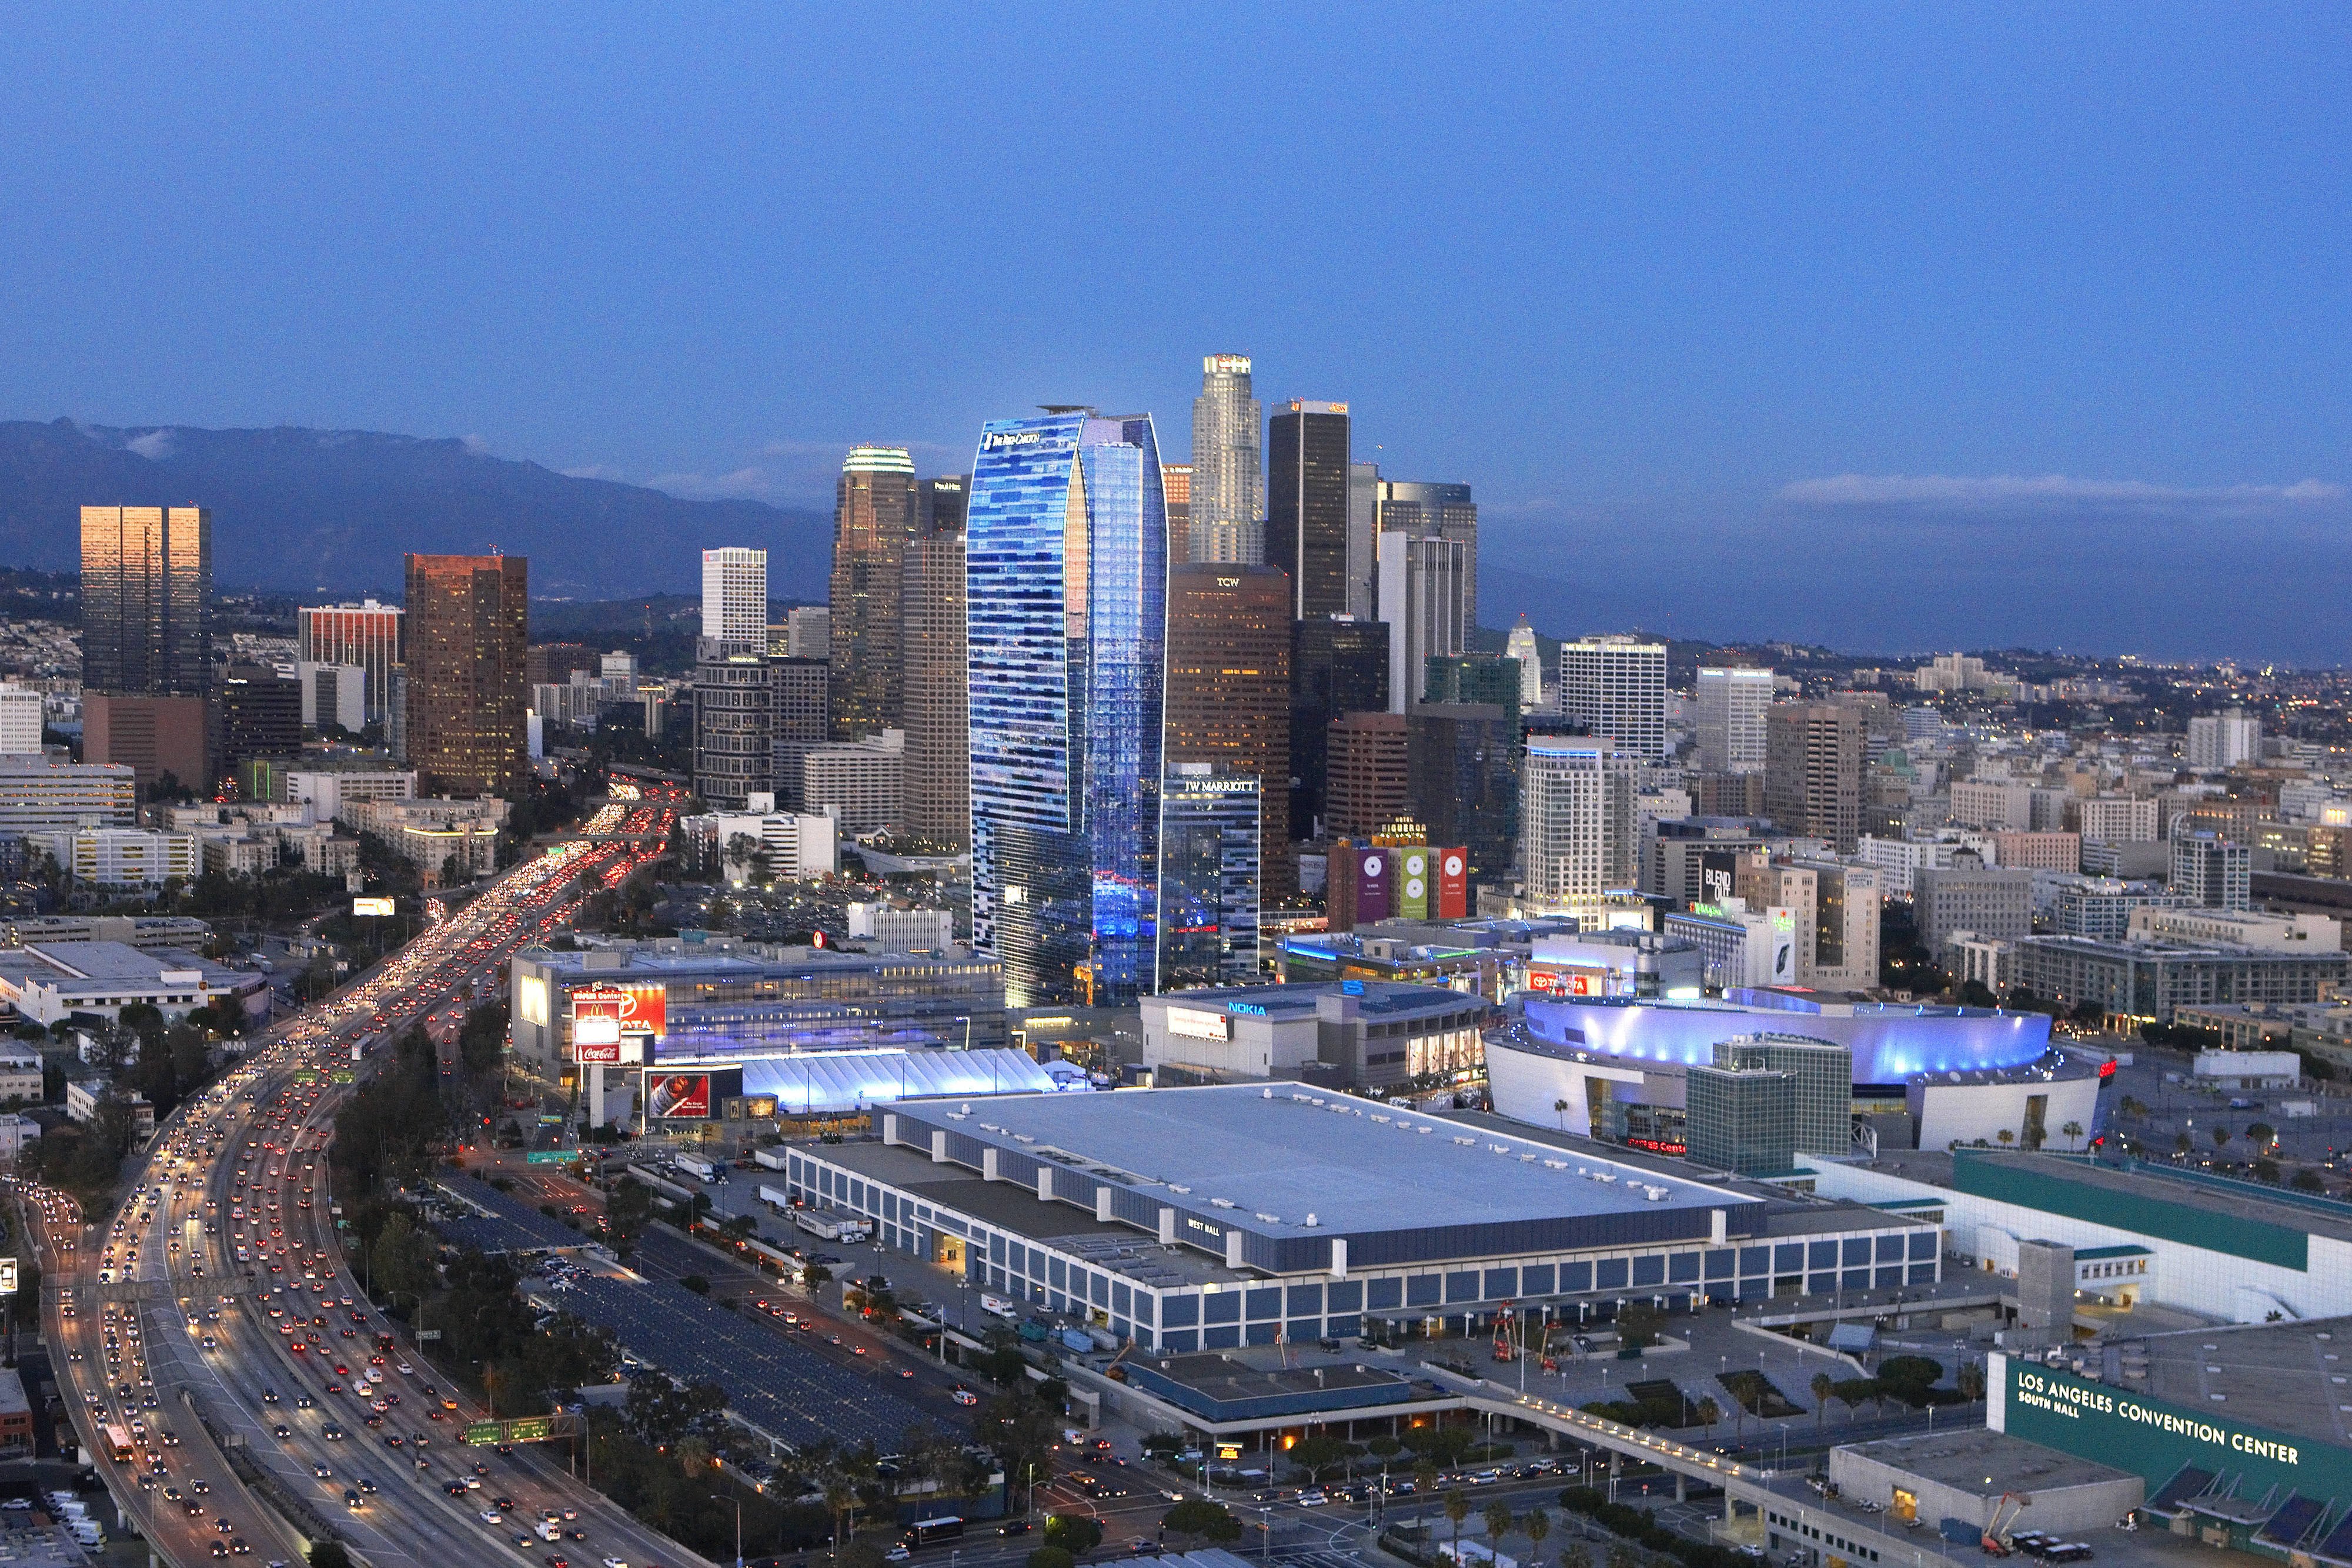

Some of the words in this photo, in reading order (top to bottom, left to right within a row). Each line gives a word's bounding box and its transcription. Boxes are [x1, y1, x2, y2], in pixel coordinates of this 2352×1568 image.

[1217, 577, 1240, 587] TCW
[1185, 781, 1200, 791] JW
[1201, 781, 1255, 791] MARRIOTT
[1382, 824, 1426, 832] FIGUEROA
[1706, 868, 1730, 886] BLEND
[1715, 887, 1730, 901] OUT
[1228, 1002, 1267, 1016] NOKIA
[1188, 1218, 1204, 1231] WEST
[1205, 1224, 1220, 1237] HALL
[2019, 1391, 2051, 1410] SOUTH
[2054, 1401, 2079, 1419] HALL
[2019, 1372, 2044, 1393] LOS
[2048, 1382, 2113, 1413] ANGELES
[2119, 1402, 2225, 1446] CONVENTION
[2231, 1434, 2298, 1465] CENTER
